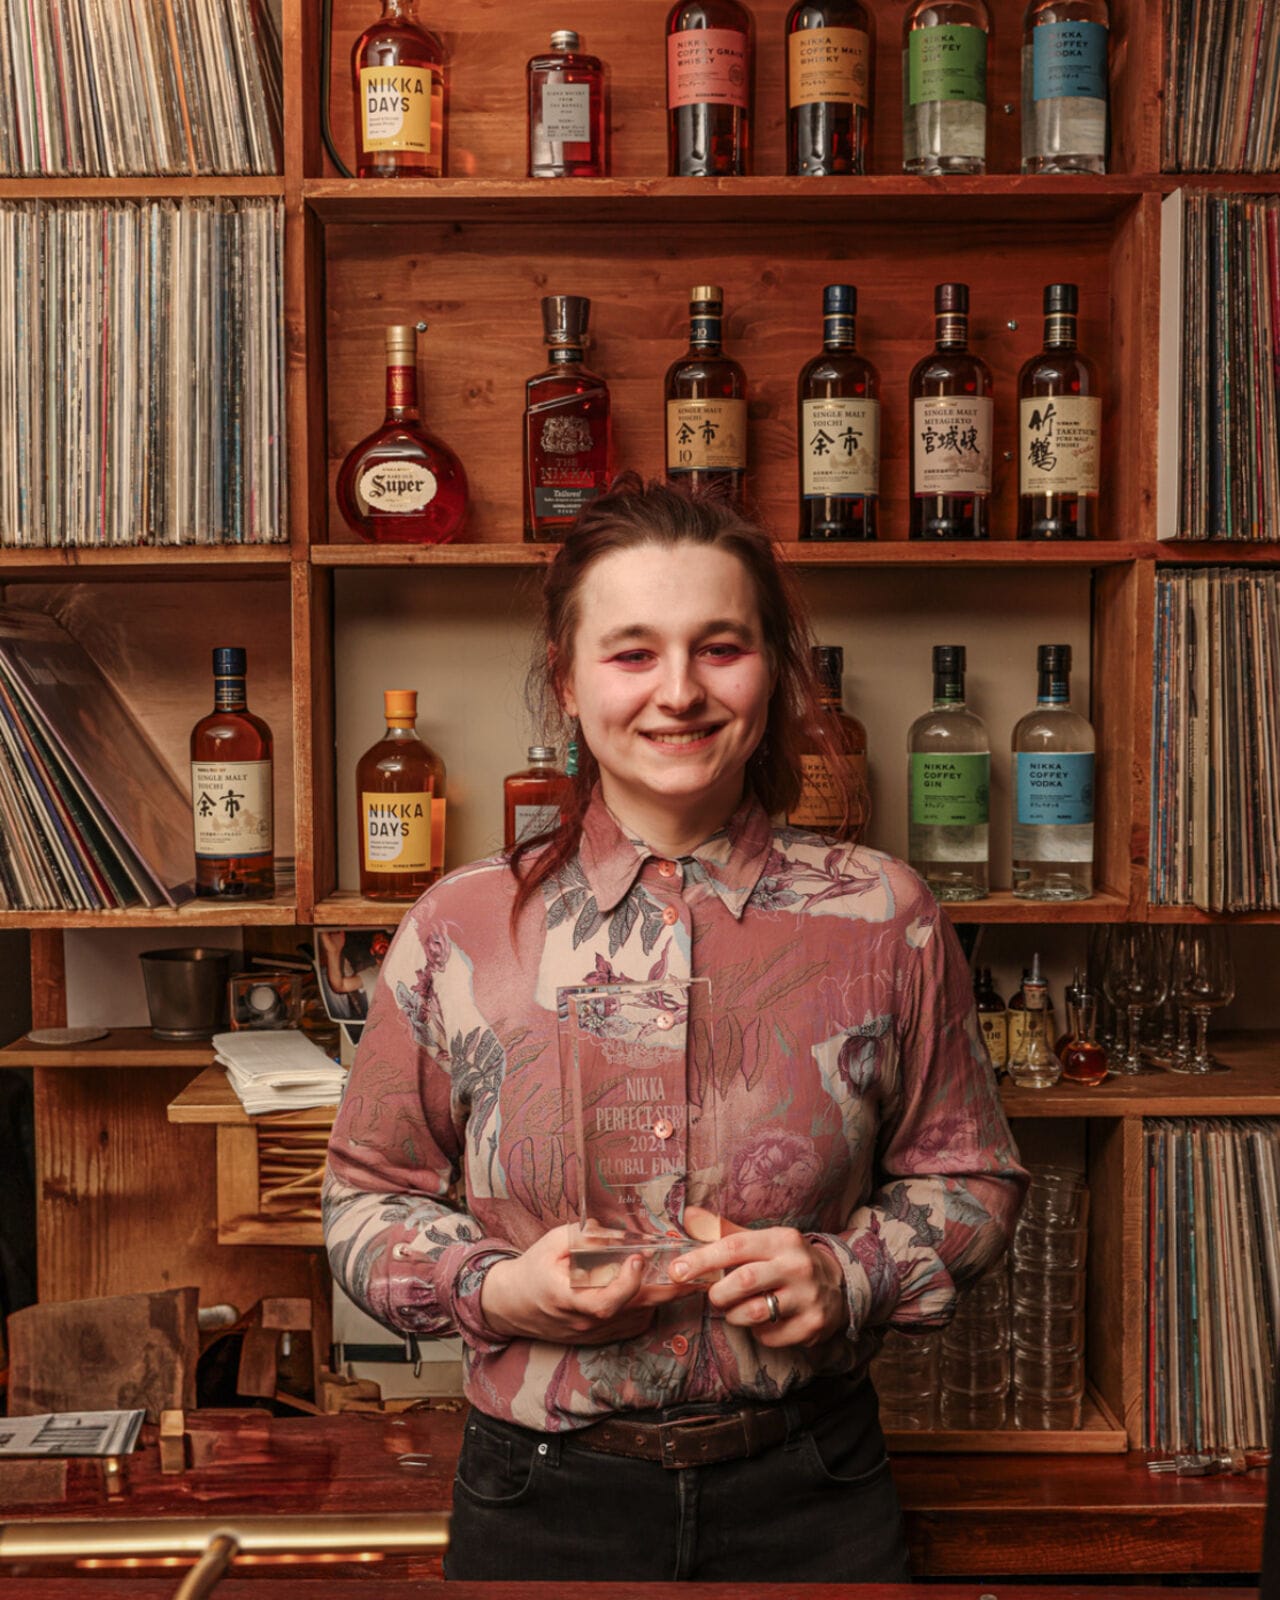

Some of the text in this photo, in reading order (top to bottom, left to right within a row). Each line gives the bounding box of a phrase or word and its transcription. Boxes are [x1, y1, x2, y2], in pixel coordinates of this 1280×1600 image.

[677, 48, 714, 58] COFFY
[368, 77, 424, 94] NIKKA
[368, 97, 410, 113] DAYS
[813, 409, 866, 418] SINGLE MALT
[924, 408, 978, 417] SINGLE MALT
[813, 420, 843, 428] YOICHI
[676, 420, 720, 446] 余市
[810, 426, 863, 457] 余市
[679, 449, 693, 463] 10
[540, 467, 592, 481] NIKKA
[369, 474, 425, 498] Super
[924, 763, 956, 771] NIKKA
[1029, 771, 1068, 779] COFFEY
[924, 780, 943, 788] GIN
[1030, 780, 1062, 788] VODKA
[197, 789, 245, 819] 余市
[369, 803, 424, 818] NIKKA
[370, 821, 410, 837] DAYS
[625, 1076, 666, 1101] NIKKA
[595, 1106, 653, 1132] PERFECT
[629, 1135, 667, 1153] 2024
